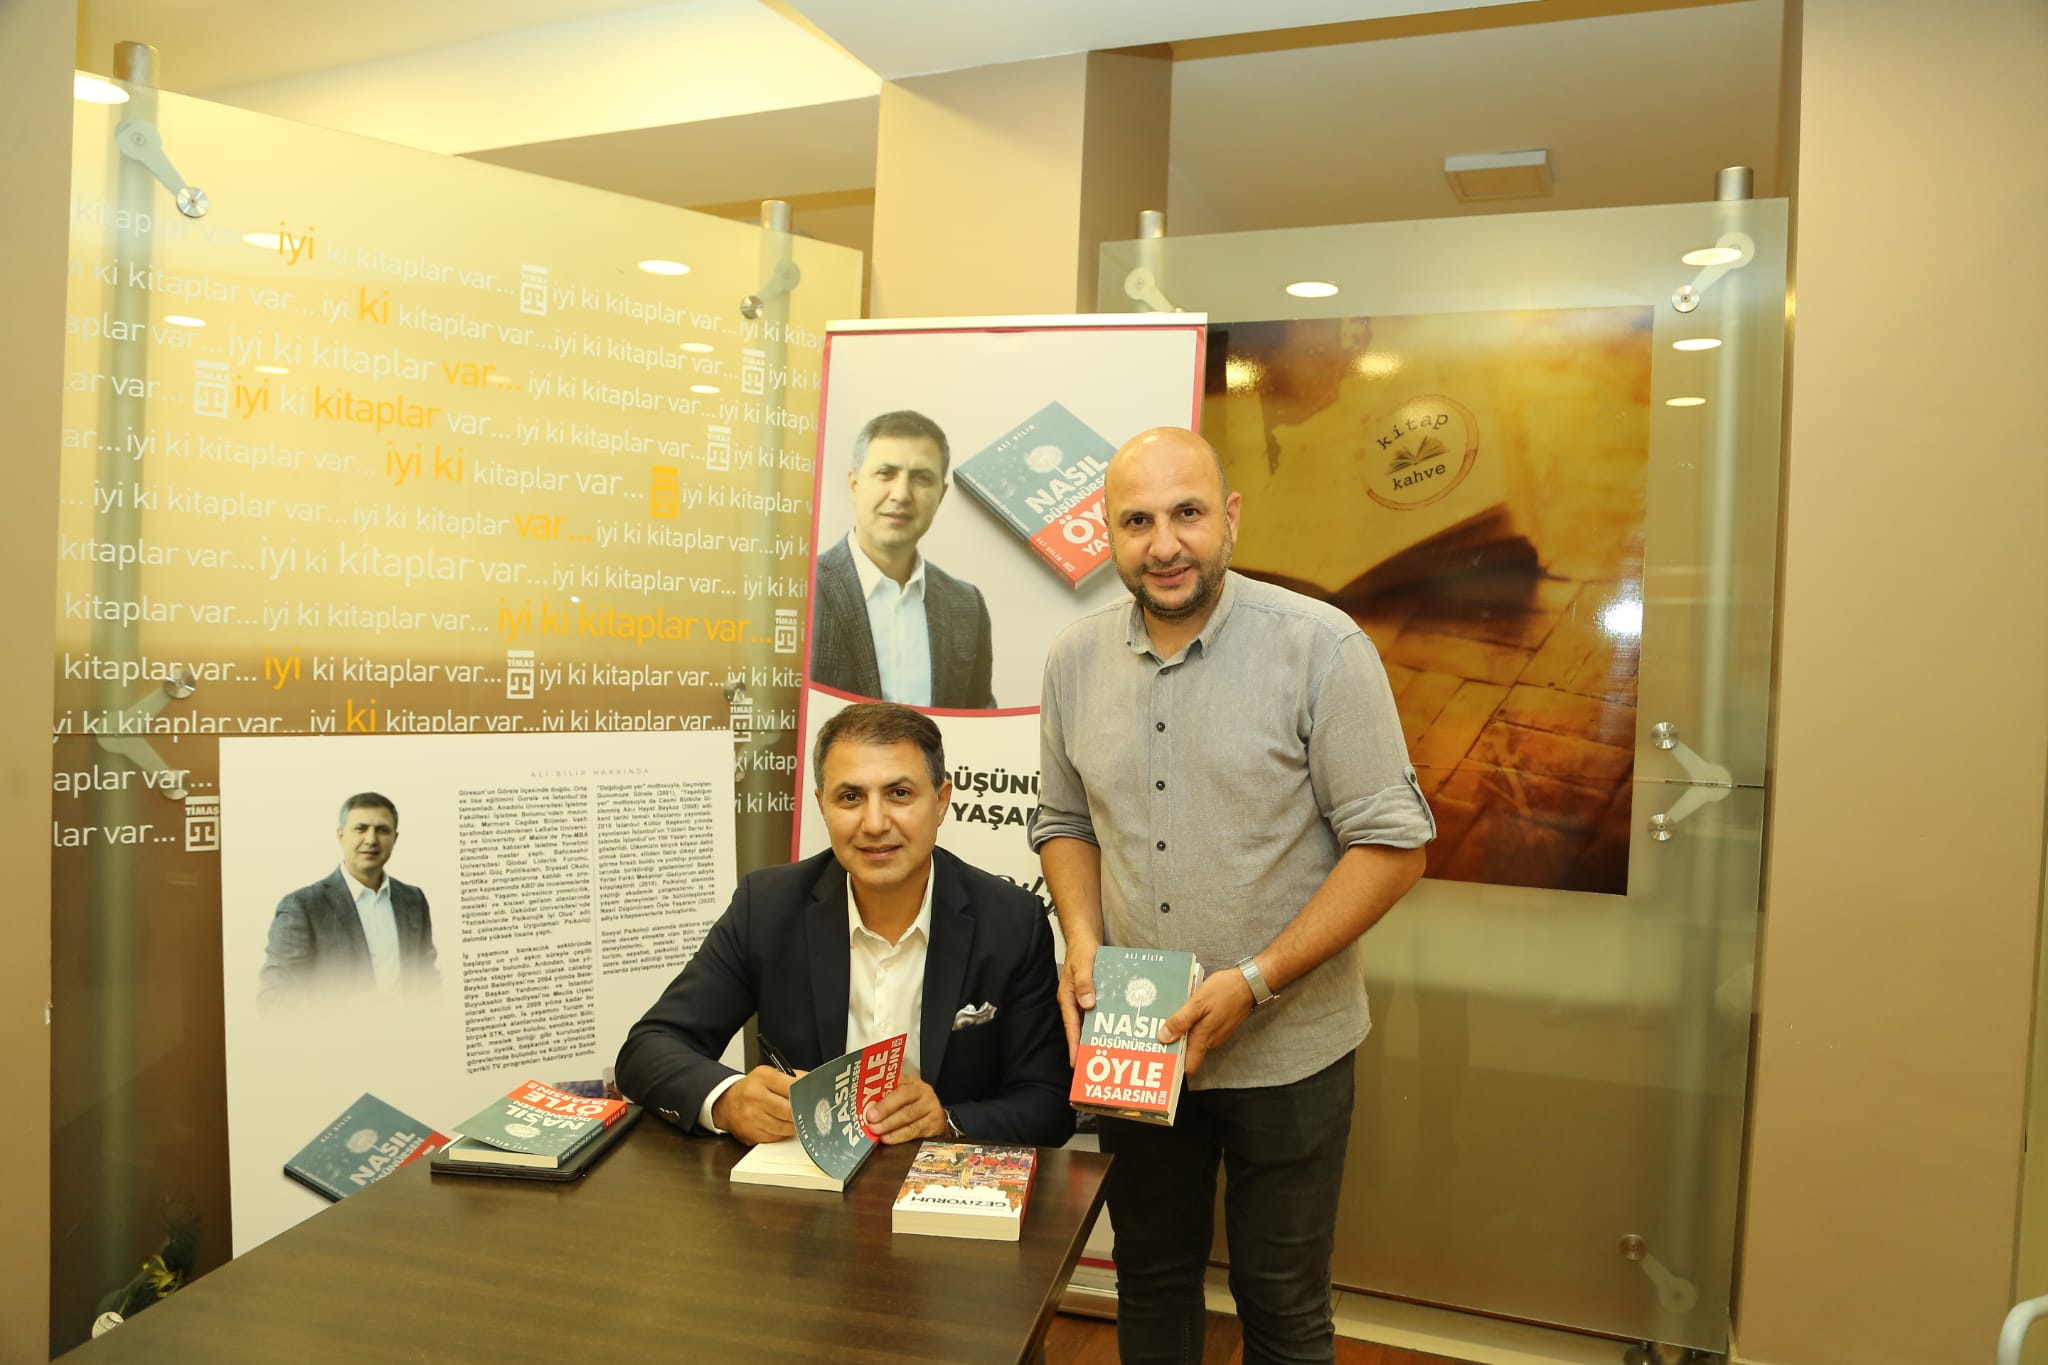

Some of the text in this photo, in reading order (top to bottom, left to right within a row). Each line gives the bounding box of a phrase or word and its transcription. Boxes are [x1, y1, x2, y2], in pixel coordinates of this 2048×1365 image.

[278, 220, 315, 267] iyi
[356, 247, 455, 283] kitaplar
[553, 281, 575, 310] iyi
[581, 287, 600, 311] ki
[606, 291, 687, 326] kitaplar
[689, 311, 737, 335] var...
[128, 261, 239, 304] kitaplar
[322, 291, 350, 324] iyi
[358, 286, 390, 326] ki
[399, 303, 494, 341] kitaplar
[497, 326, 552, 351] var...
[554, 328, 577, 358] iyi
[583, 333, 601, 357] ki
[607, 336, 687, 371] kitaplar
[691, 357, 739, 380] var...
[768, 363, 787, 390] iyi
[228, 325, 739, 425] iyi ki kitaplar iyi kitaplar var... iyi
[111, 374, 753, 470] var... iyi kitaplar var... iyi kitaplar var... iyi
[1376, 413, 1449, 451] kitap
[126, 426, 803, 517] iyi kitaplar iyi ki kitaplar var... iyi kitaplar
[1024, 455, 1110, 515] NASIL
[1391, 463, 1447, 491] kahve
[93, 479, 794, 560] iyi ki kitaplar iyi kitaplar var... iyi kitaplar var... iyi
[60, 533, 763, 601] kitaplar var... iyi kitaplar var... iyi kitaplar var... iyi
[64, 592, 773, 649] kitaplar var... iyi ki kitaplar var... iyi ki kitaplar var...
[63, 645, 724, 692] kitaplar var... iyi ki kitaplar var... iyi ki kitaplar var...
[117, 697, 728, 744] kitaplar ki kitaplar var... kitaplar var...
[141, 769, 213, 791] var...
[103, 823, 176, 846] var...
[1085, 1049, 1165, 1089] ÖYLE
[1090, 1035, 1168, 1054] DÜŞÜNÜRSEN
[505, 1103, 586, 1131] NASIL
[523, 1089, 605, 1118] ÖYLE
[834, 1062, 862, 1148] NASIL
[1083, 1083, 1158, 1106] YAŞARSIN
[349, 1130, 417, 1187] NASIL
